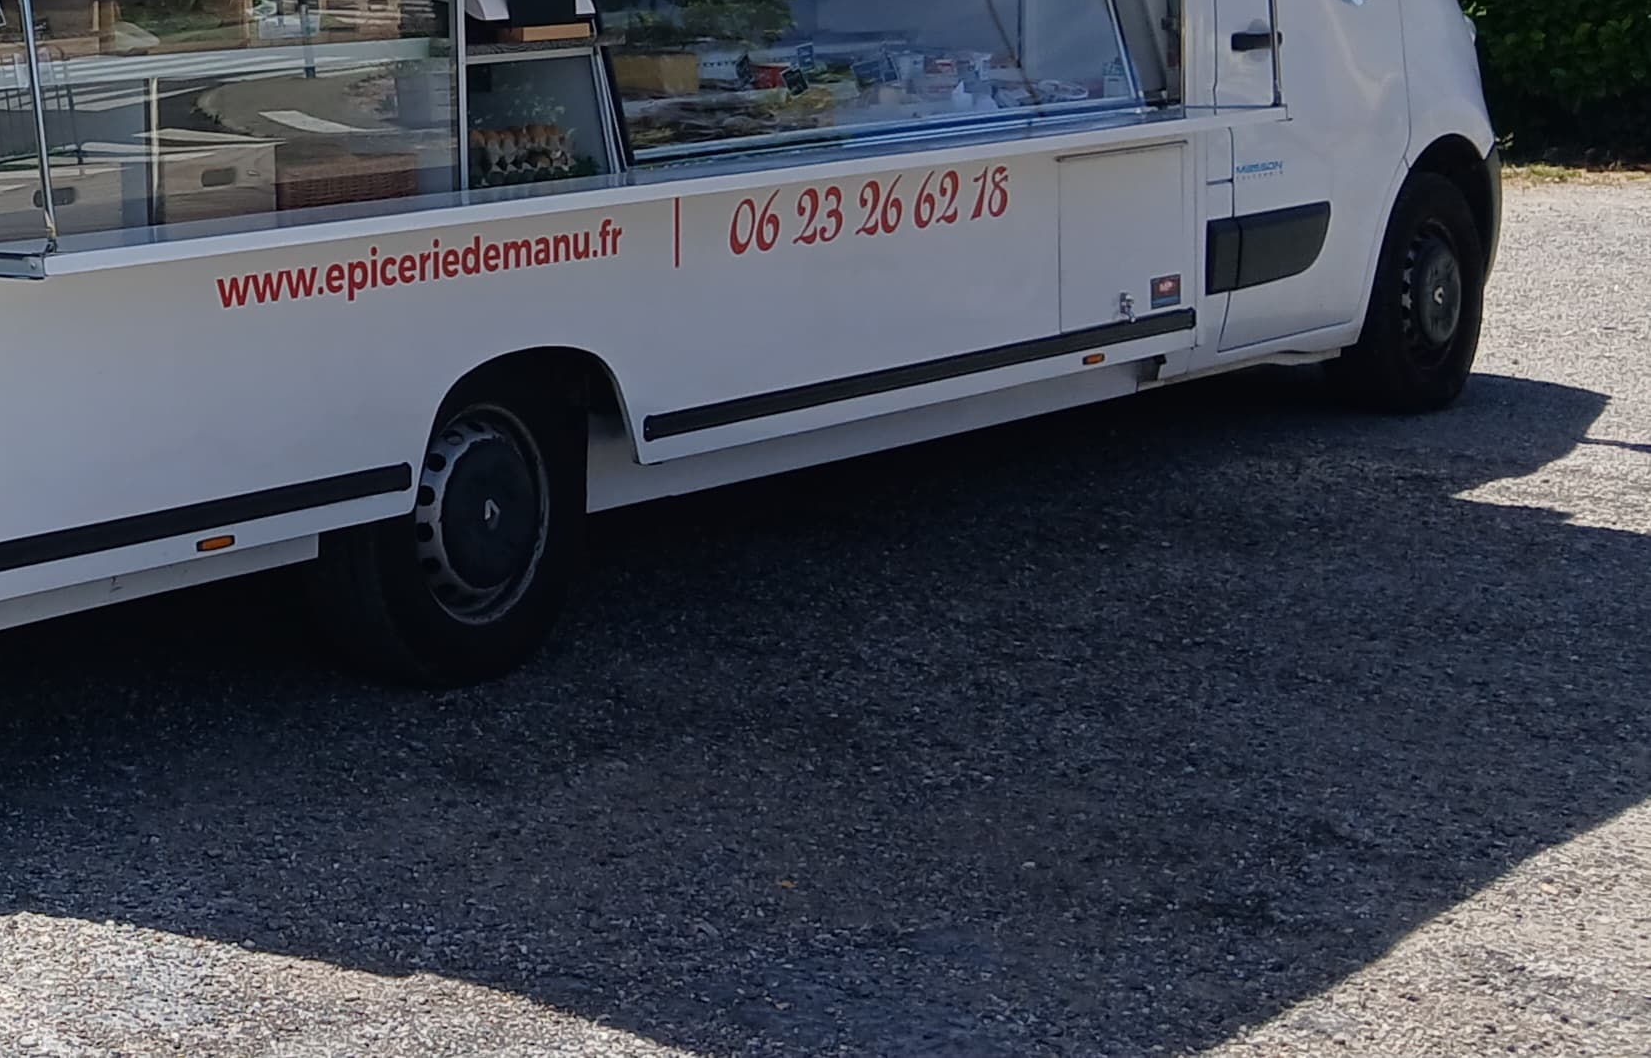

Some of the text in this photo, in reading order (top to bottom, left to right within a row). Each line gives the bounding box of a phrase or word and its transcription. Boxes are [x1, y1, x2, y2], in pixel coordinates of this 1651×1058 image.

[729, 165, 1009, 255] 06 23 26 62 18
[217, 218, 622, 308] www.epiceriedemanu.fr
